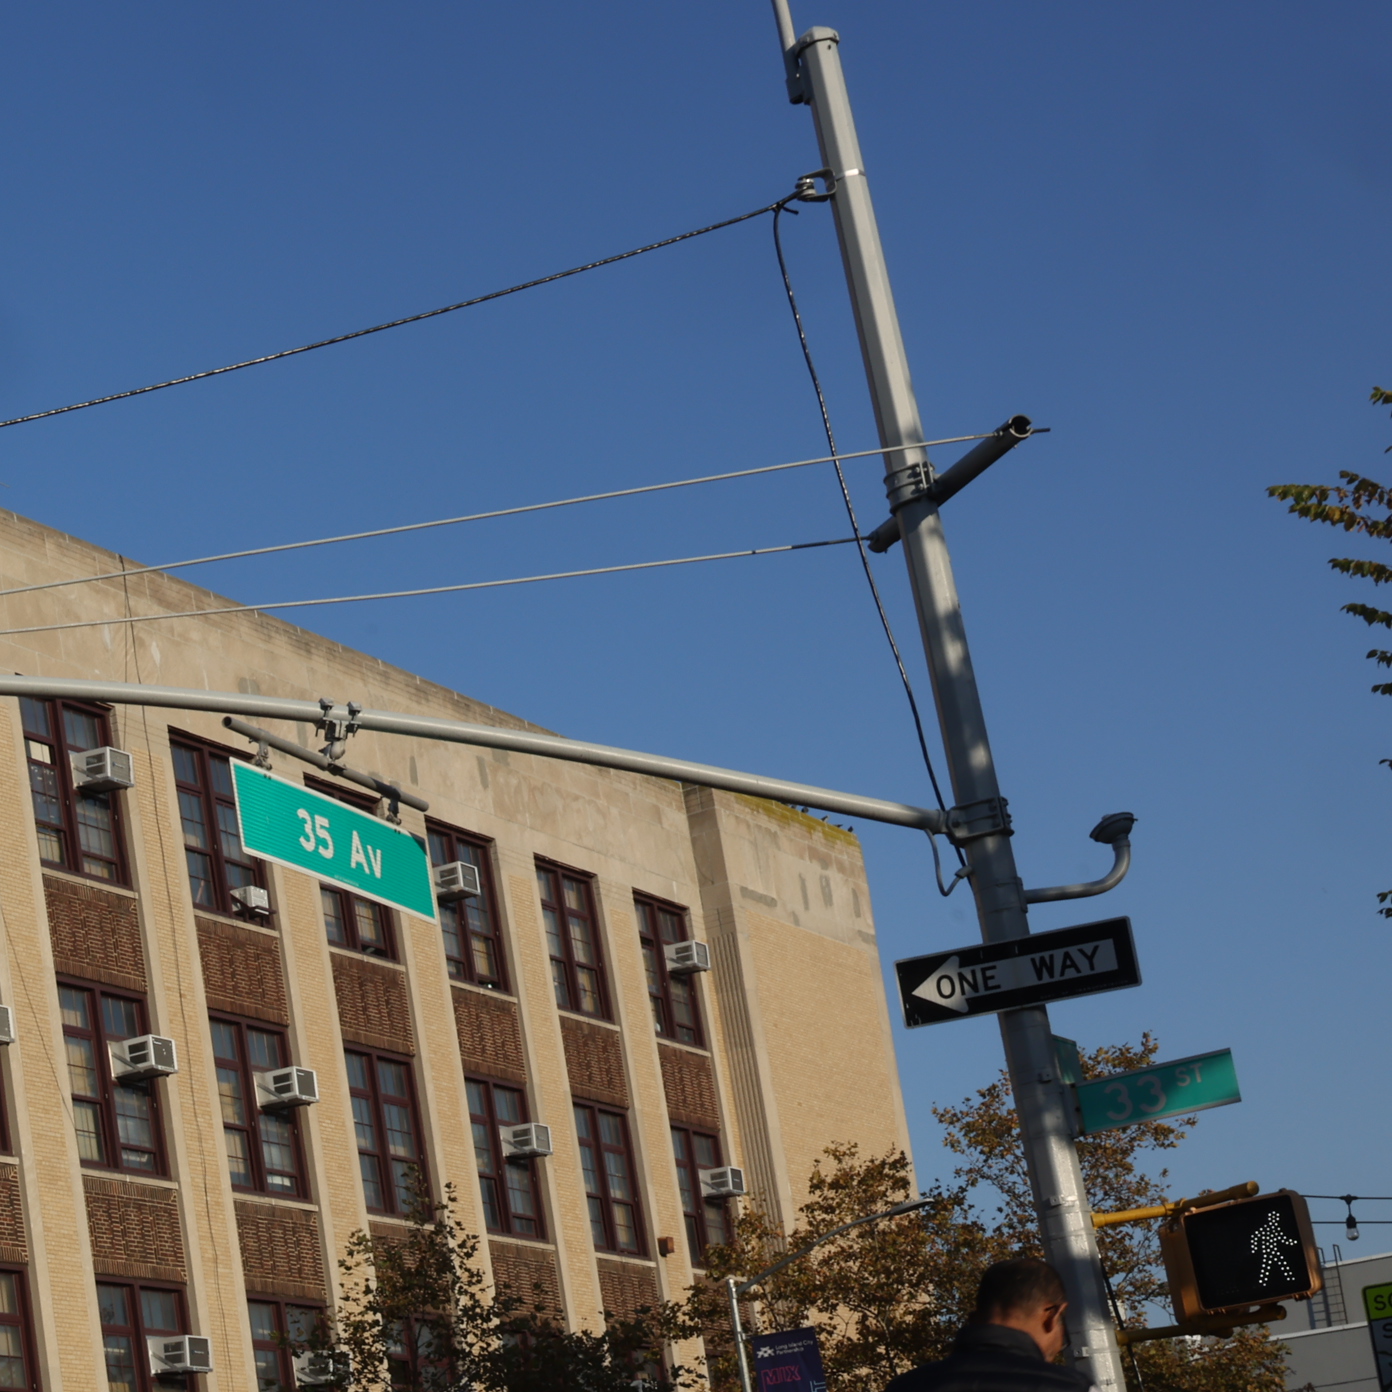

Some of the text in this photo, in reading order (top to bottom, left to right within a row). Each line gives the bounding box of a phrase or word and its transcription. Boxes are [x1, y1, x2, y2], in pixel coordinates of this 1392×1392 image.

[296, 808, 382, 880] 35 AV
[936, 945, 1100, 1000] ONE WAY
[1104, 1063, 1203, 1121] 33 ST
[761, 1365, 802, 1385] MIX
